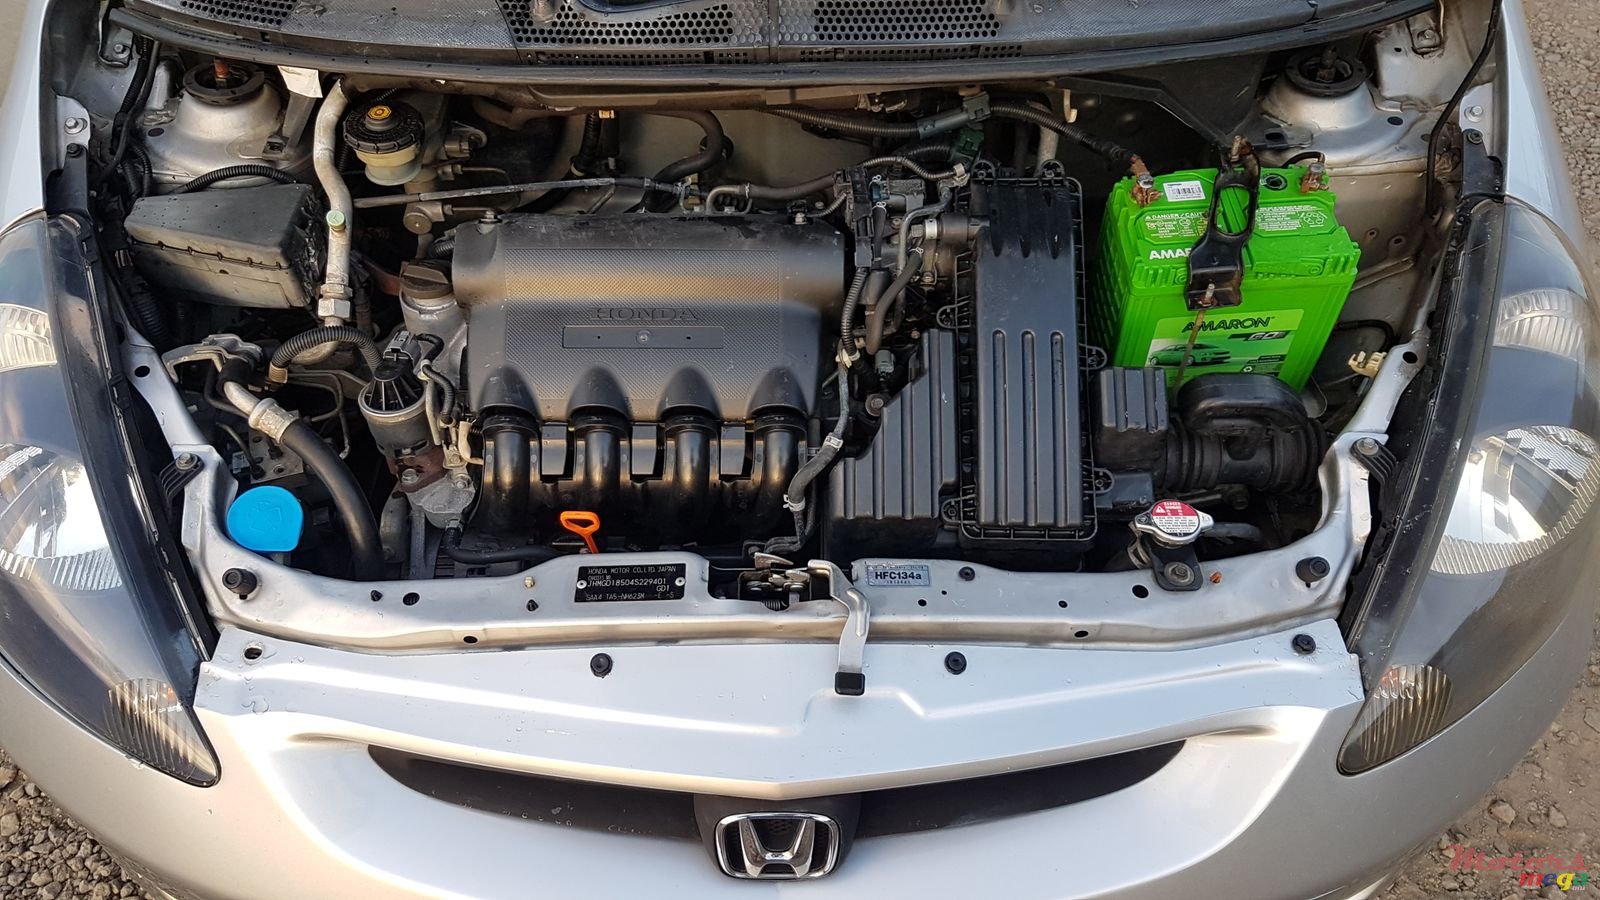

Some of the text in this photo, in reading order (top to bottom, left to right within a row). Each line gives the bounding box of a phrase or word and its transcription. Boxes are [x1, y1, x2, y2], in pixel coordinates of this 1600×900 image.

[1185, 211, 1202, 219] CAUT
[1149, 247, 1192, 260] AMA
[590, 307, 698, 321] HONDA
[1182, 317, 1270, 333] AMARON
[657, 565, 677, 573] JAPAN
[875, 571, 922, 580] HFC134a
[587, 578, 666, 588] JHMGD18504S229401
